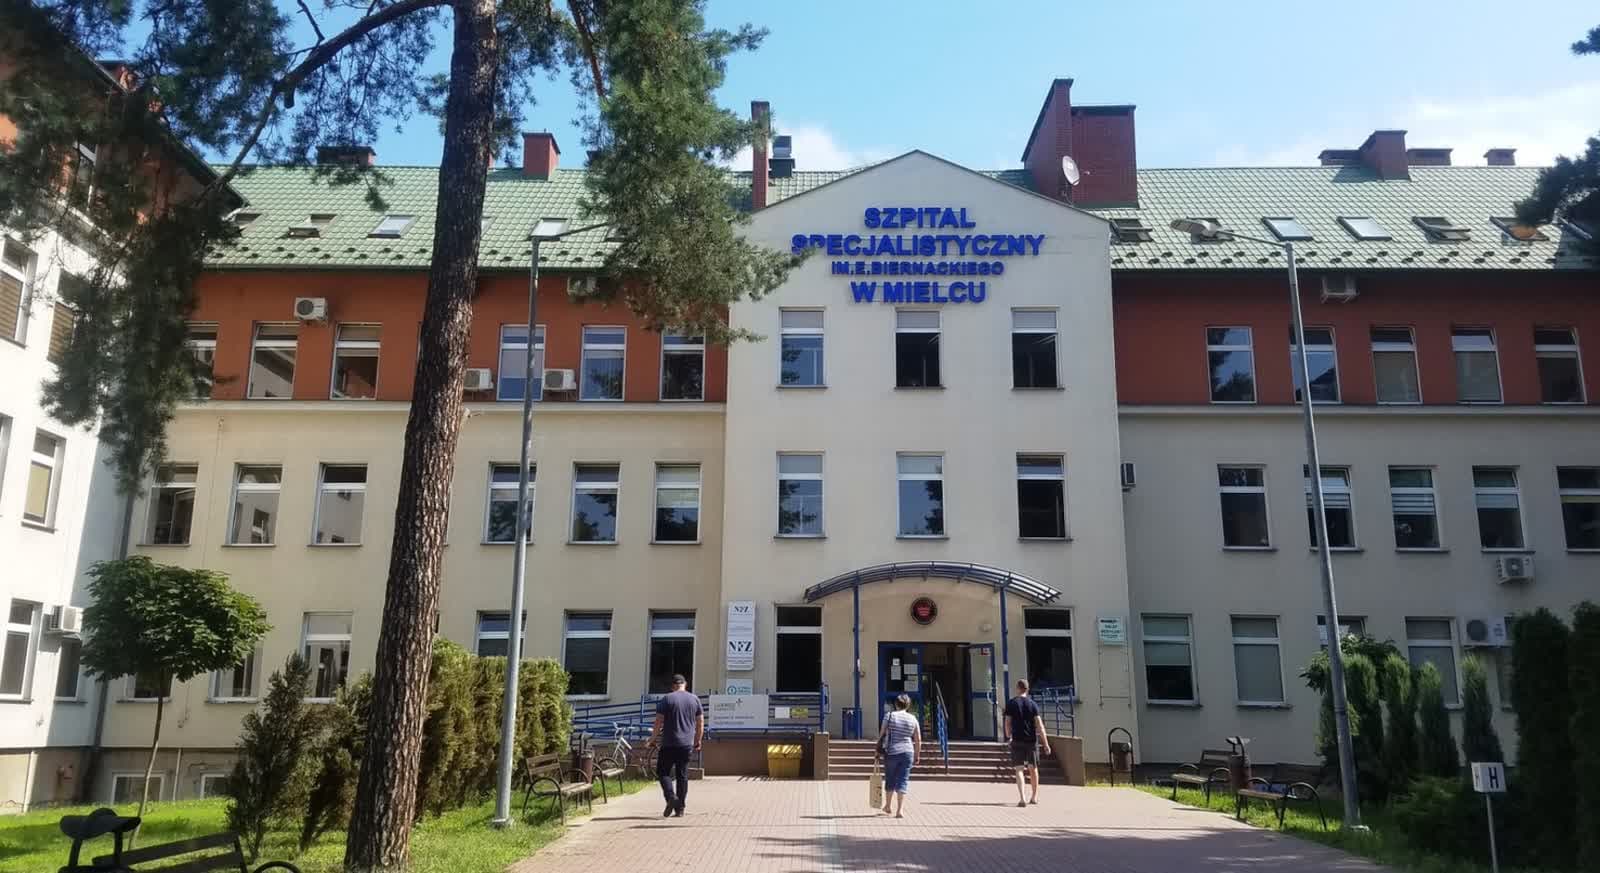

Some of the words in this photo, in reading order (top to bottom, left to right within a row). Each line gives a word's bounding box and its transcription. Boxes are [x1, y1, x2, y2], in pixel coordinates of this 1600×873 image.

[864, 207, 976, 229] SZPITAL
[791, 234, 1045, 256] SPECJALISTYCZNY
[850, 281, 877, 303] W
[883, 281, 986, 303] MIELCU
[728, 640, 753, 652] NFZ
[1488, 766, 1499, 789] H
